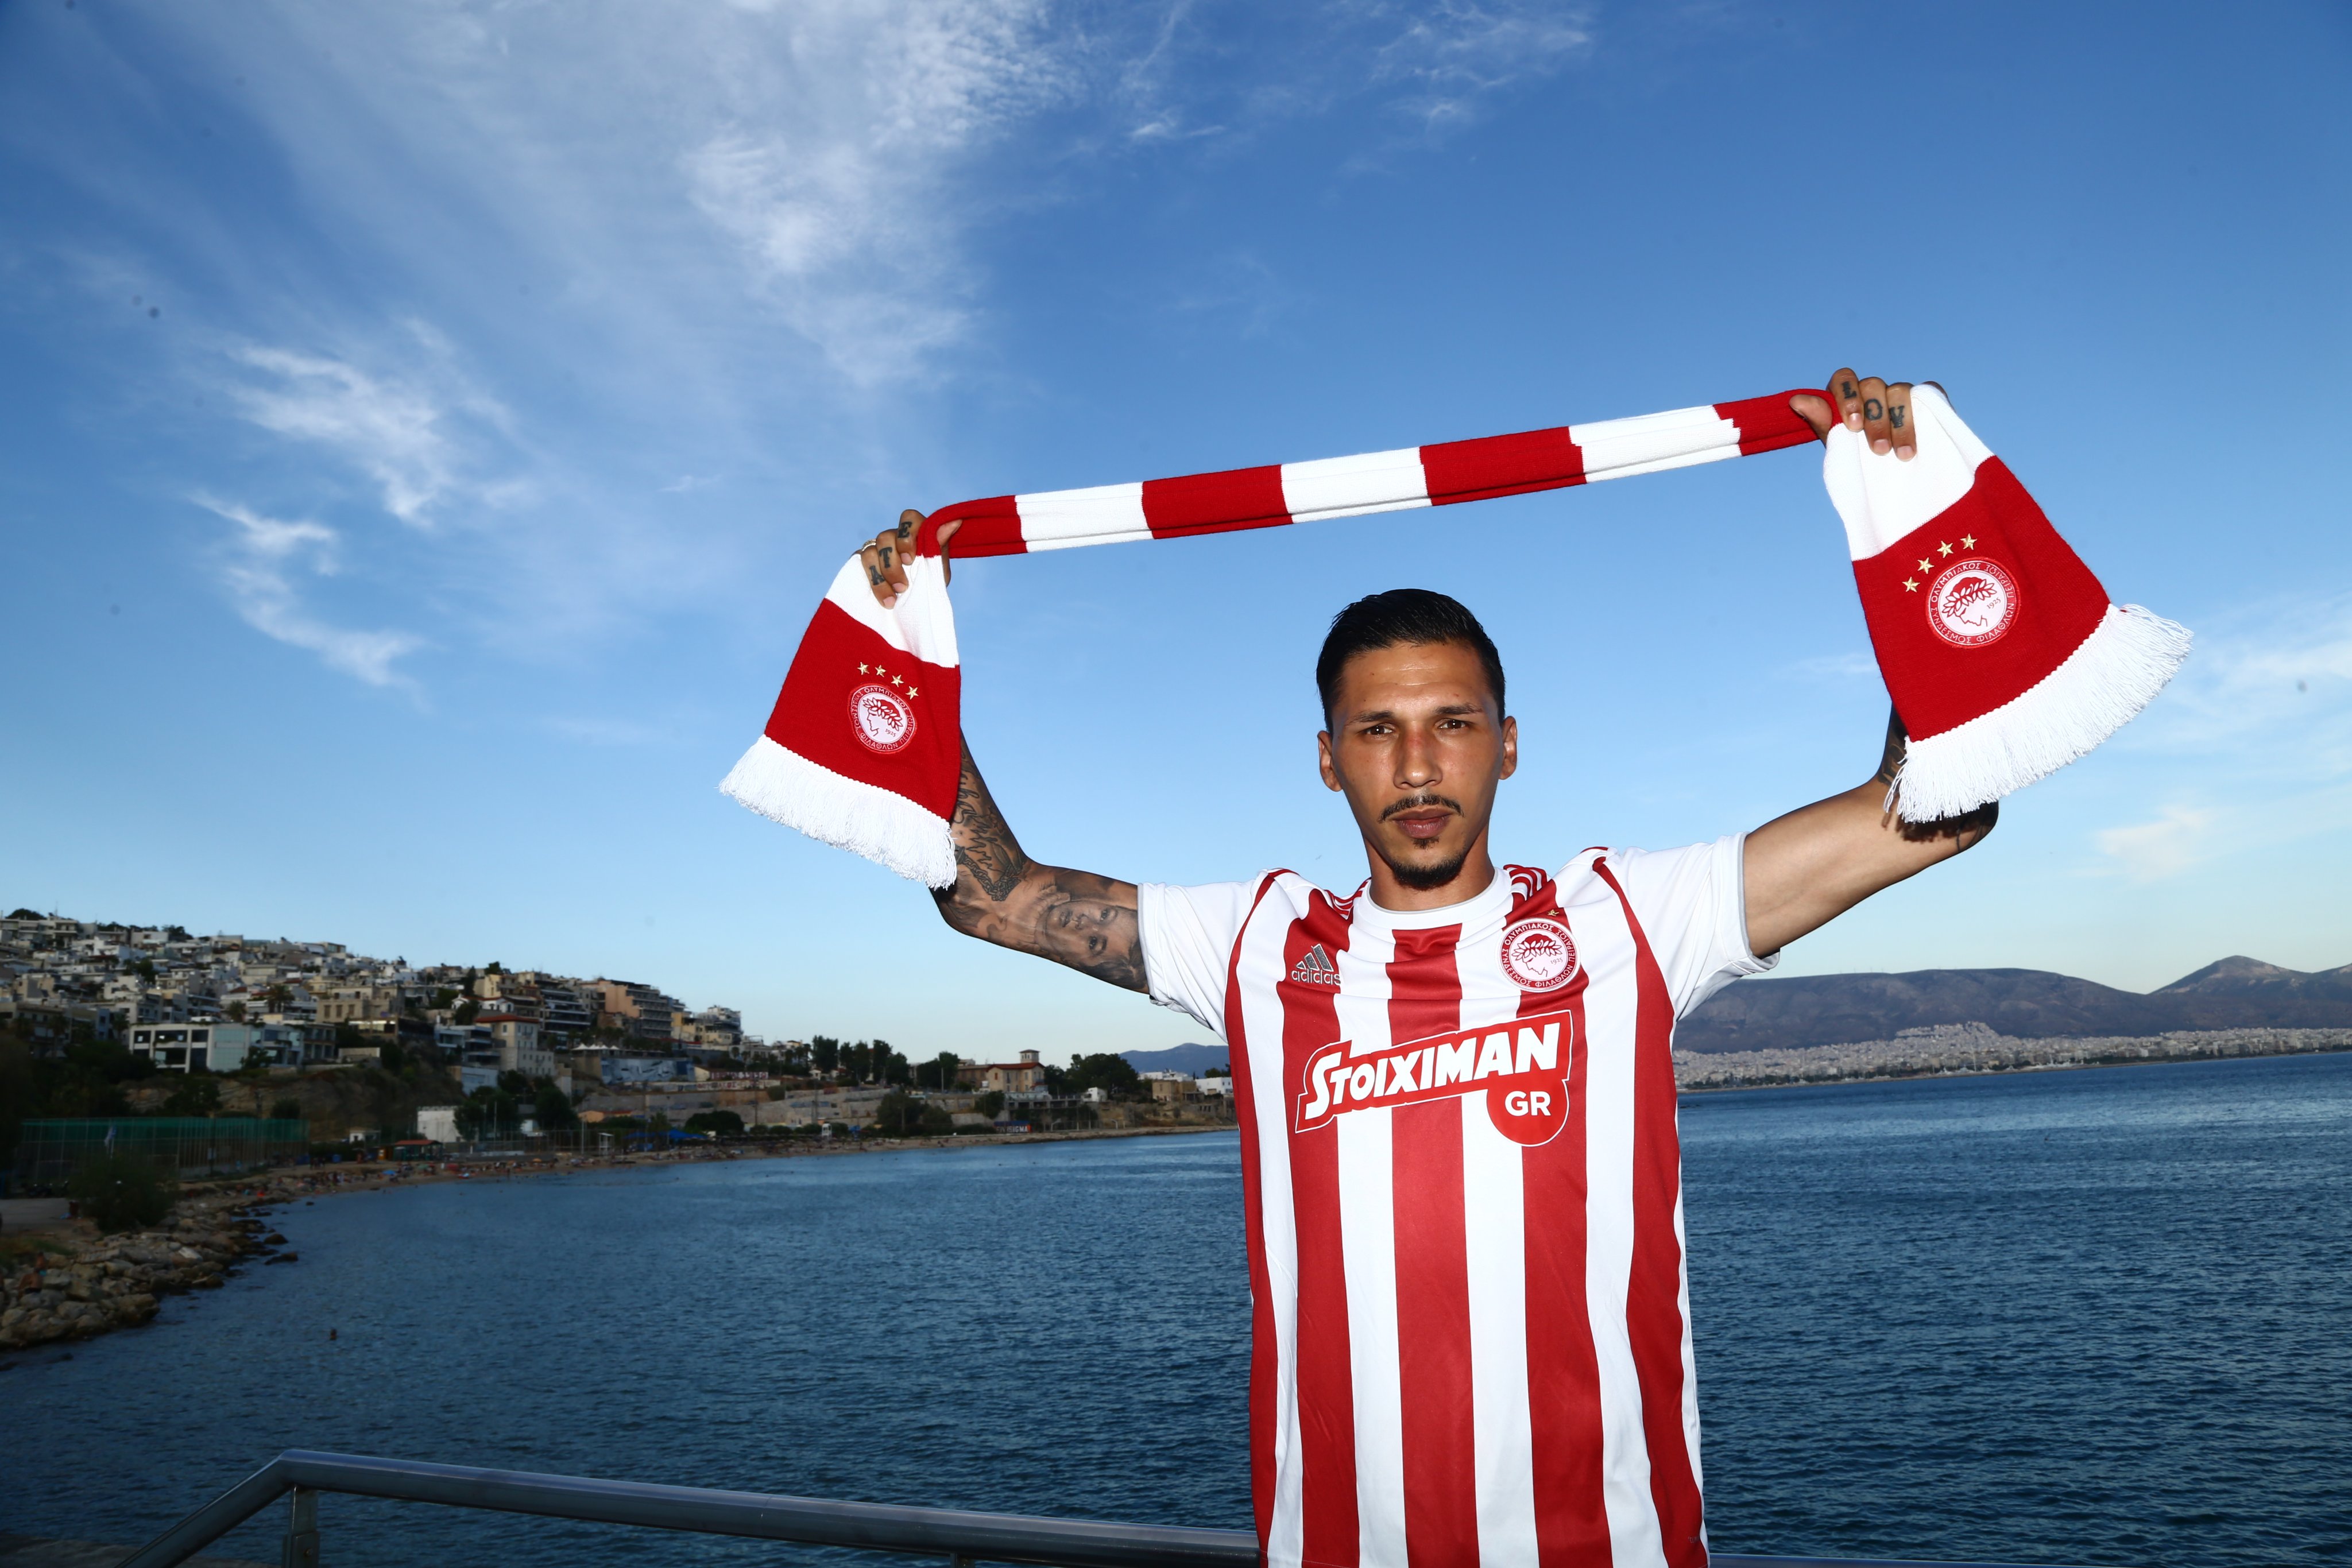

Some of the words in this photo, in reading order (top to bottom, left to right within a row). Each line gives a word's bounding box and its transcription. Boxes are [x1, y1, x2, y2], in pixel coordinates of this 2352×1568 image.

[1842, 381, 1905, 428] LOV
[869, 521, 912, 586] ATE
[1931, 563, 1981, 603] ΟΛΥΜΠΙΑΚΟΣ
[1984, 564, 2015, 598] ΠΕΙΡΑΙΩΣ
[1986, 597, 2001, 610] 1925
[1931, 607, 1972, 644] ΣΥΝΔΕΣΜΟΣ
[1976, 603, 2015, 642] ΦΙΛΑΘΛΩΝ
[852, 691, 864, 731] ΣΥΝΔΕΣΜΟΣ
[864, 687, 908, 711] ΟΛΥΜΠΙΑΚΟΣ
[860, 732, 899, 750] ΦΙΛΑΘΛΩΝ
[885, 728, 896, 738] 1925
[900, 715, 914, 745] ΠΕΙΡΑΙΩΣ
[1504, 923, 1554, 946] ΟΛΥΜΠΙΑΚΟΣ
[1556, 929, 1576, 962] ΠΕΙΡΑΙΩΣ
[1291, 969, 1341, 986] adidas
[1502, 948, 1531, 987] ΣΥΝΔΕΣΜΟΣ
[1535, 965, 1573, 987] ΦΙΛΑΘΛΩΝ
[1305, 1022, 1560, 1120] STOIXIMAN
[1504, 1090, 1551, 1117] GR
